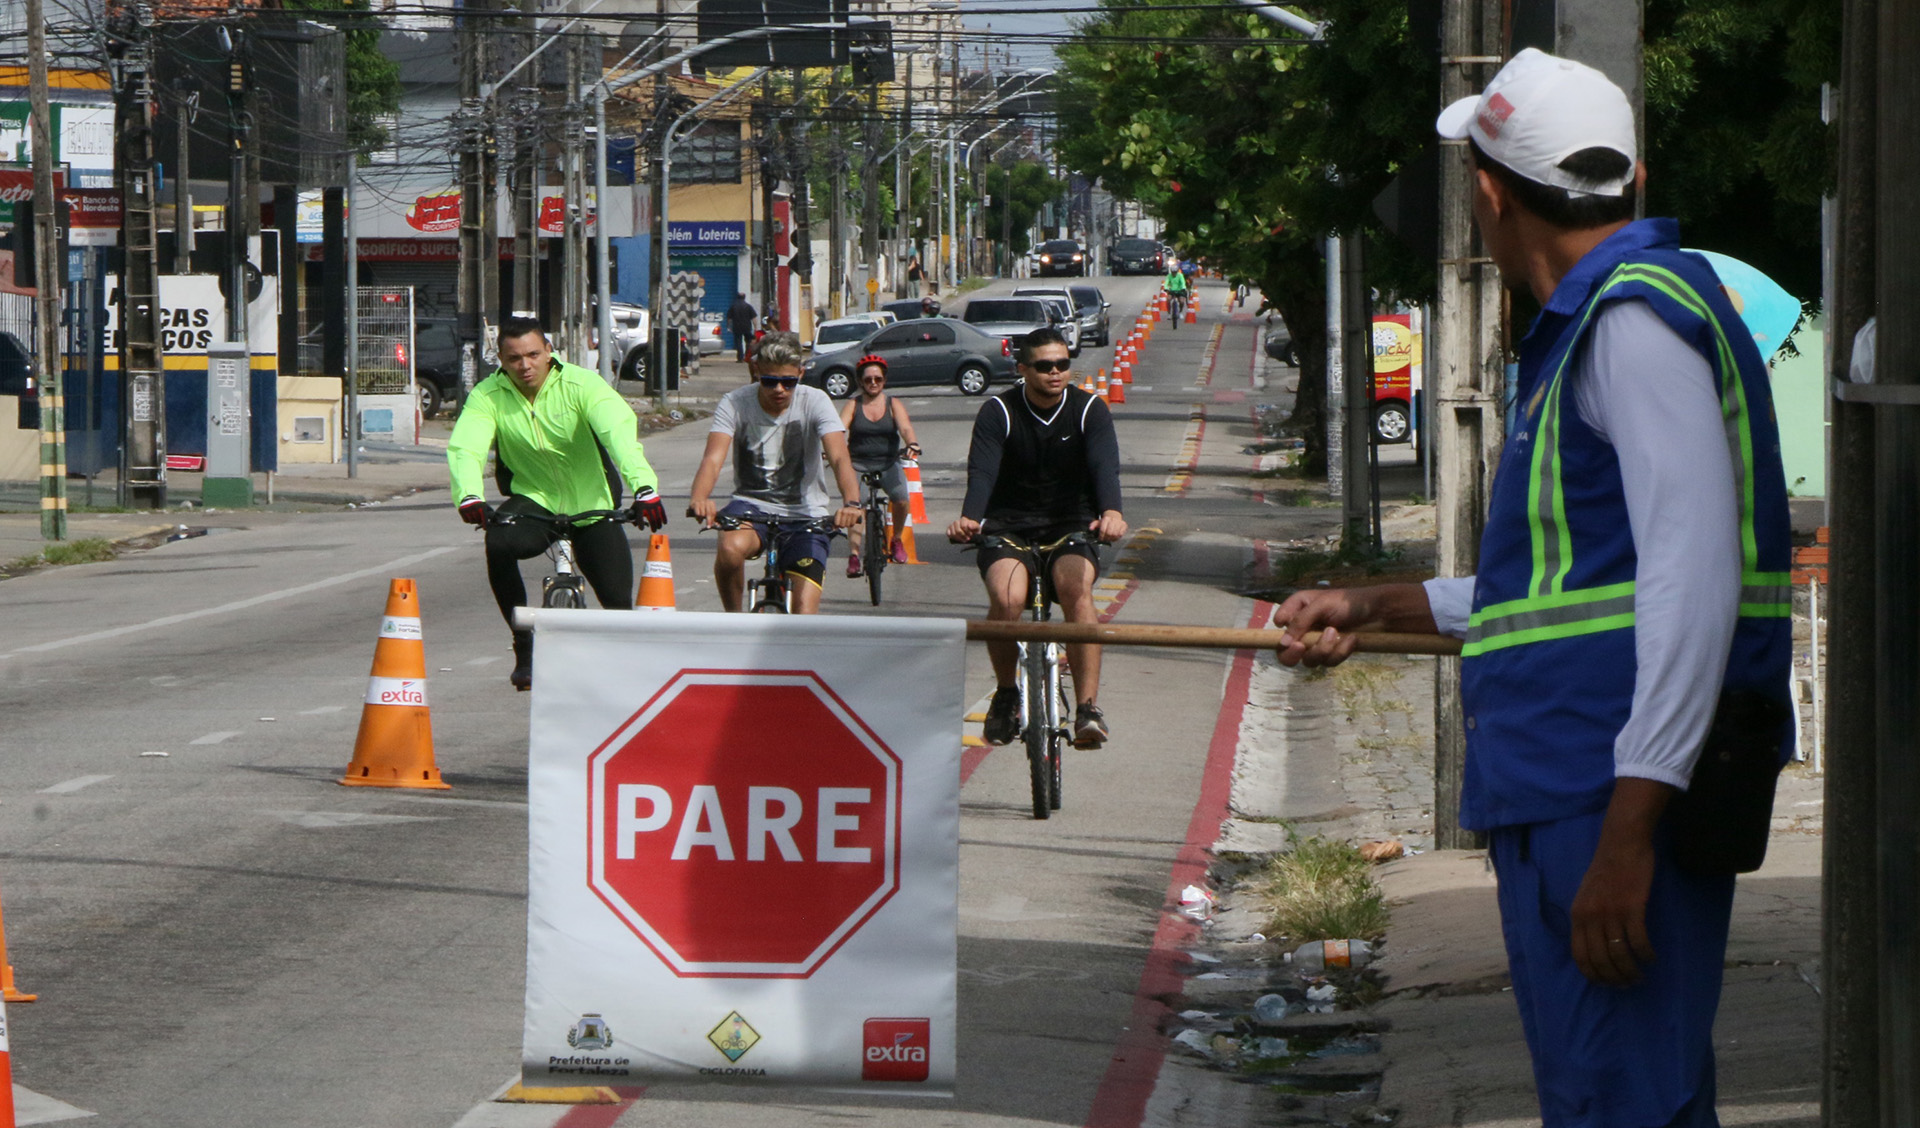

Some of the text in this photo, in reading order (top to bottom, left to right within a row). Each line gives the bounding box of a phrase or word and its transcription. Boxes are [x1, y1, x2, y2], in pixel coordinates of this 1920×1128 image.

[82, 195, 120, 204] Banco do
[82, 204, 120, 212] Nordeste
[667, 227, 741, 241] elém Loterias
[381, 690, 422, 703] extra
[615, 783, 872, 864] PARE
[866, 1043, 926, 1063] extra
[548, 1055, 630, 1066] Prefeitura de
[548, 1066, 630, 1076] Fortaleza
[699, 1067, 767, 1077] CICLOFAIXA
